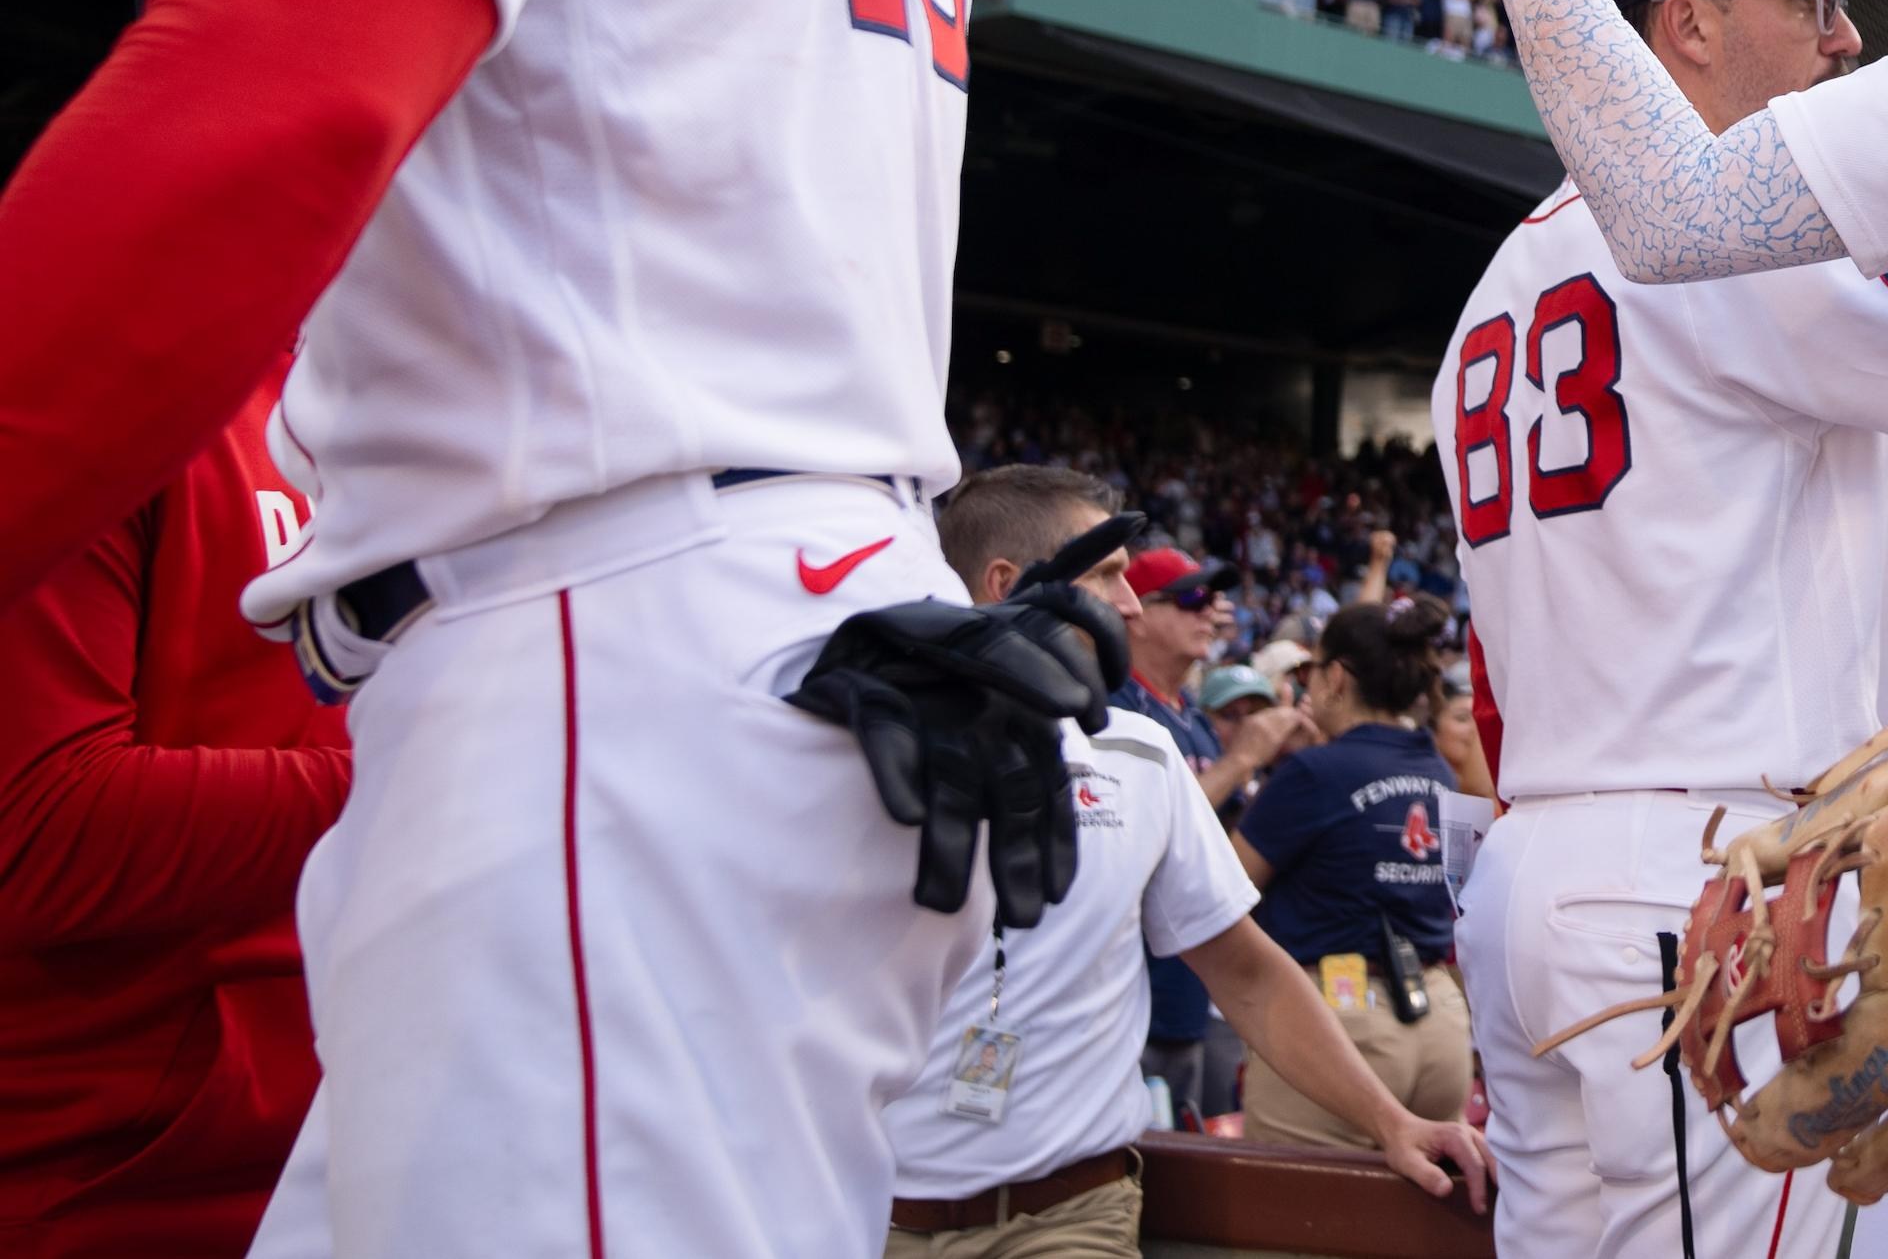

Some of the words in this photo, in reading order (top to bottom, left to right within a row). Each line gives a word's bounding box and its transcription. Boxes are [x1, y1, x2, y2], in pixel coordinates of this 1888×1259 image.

[1455, 271, 1632, 549] 83
[1351, 775, 1431, 813] FENWAY
[1374, 861, 1445, 884] SECURIT
